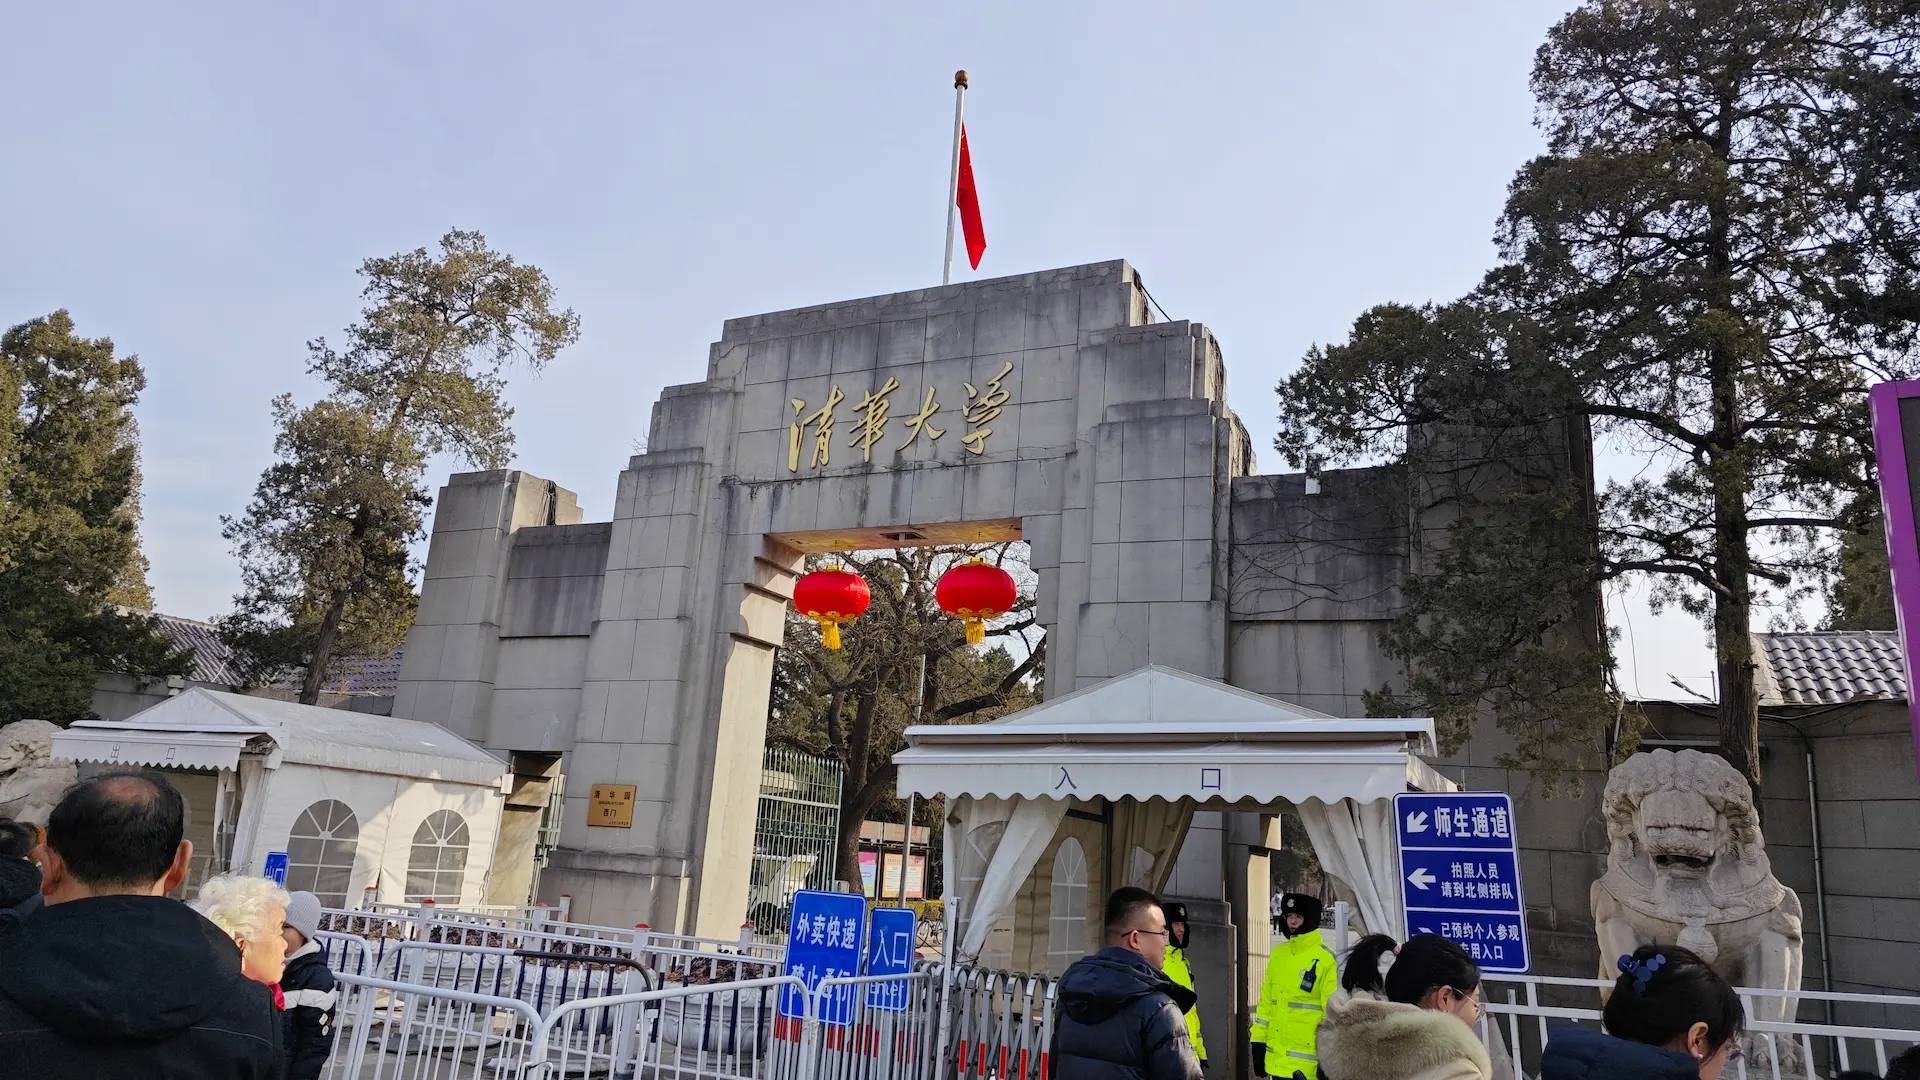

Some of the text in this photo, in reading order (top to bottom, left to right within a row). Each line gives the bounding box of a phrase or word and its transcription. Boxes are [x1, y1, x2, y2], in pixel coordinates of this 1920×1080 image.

[603, 808, 617, 817] 西门
[1434, 806, 1509, 838] 师生通道
[1451, 862, 1499, 880] 拍照人员
[1441, 881, 1514, 900] 请到北侧排队
[796, 912, 857, 949] 外卖快递
[1440, 922, 1520, 942] 已预约个人参观
[872, 929, 909, 968] 入口
